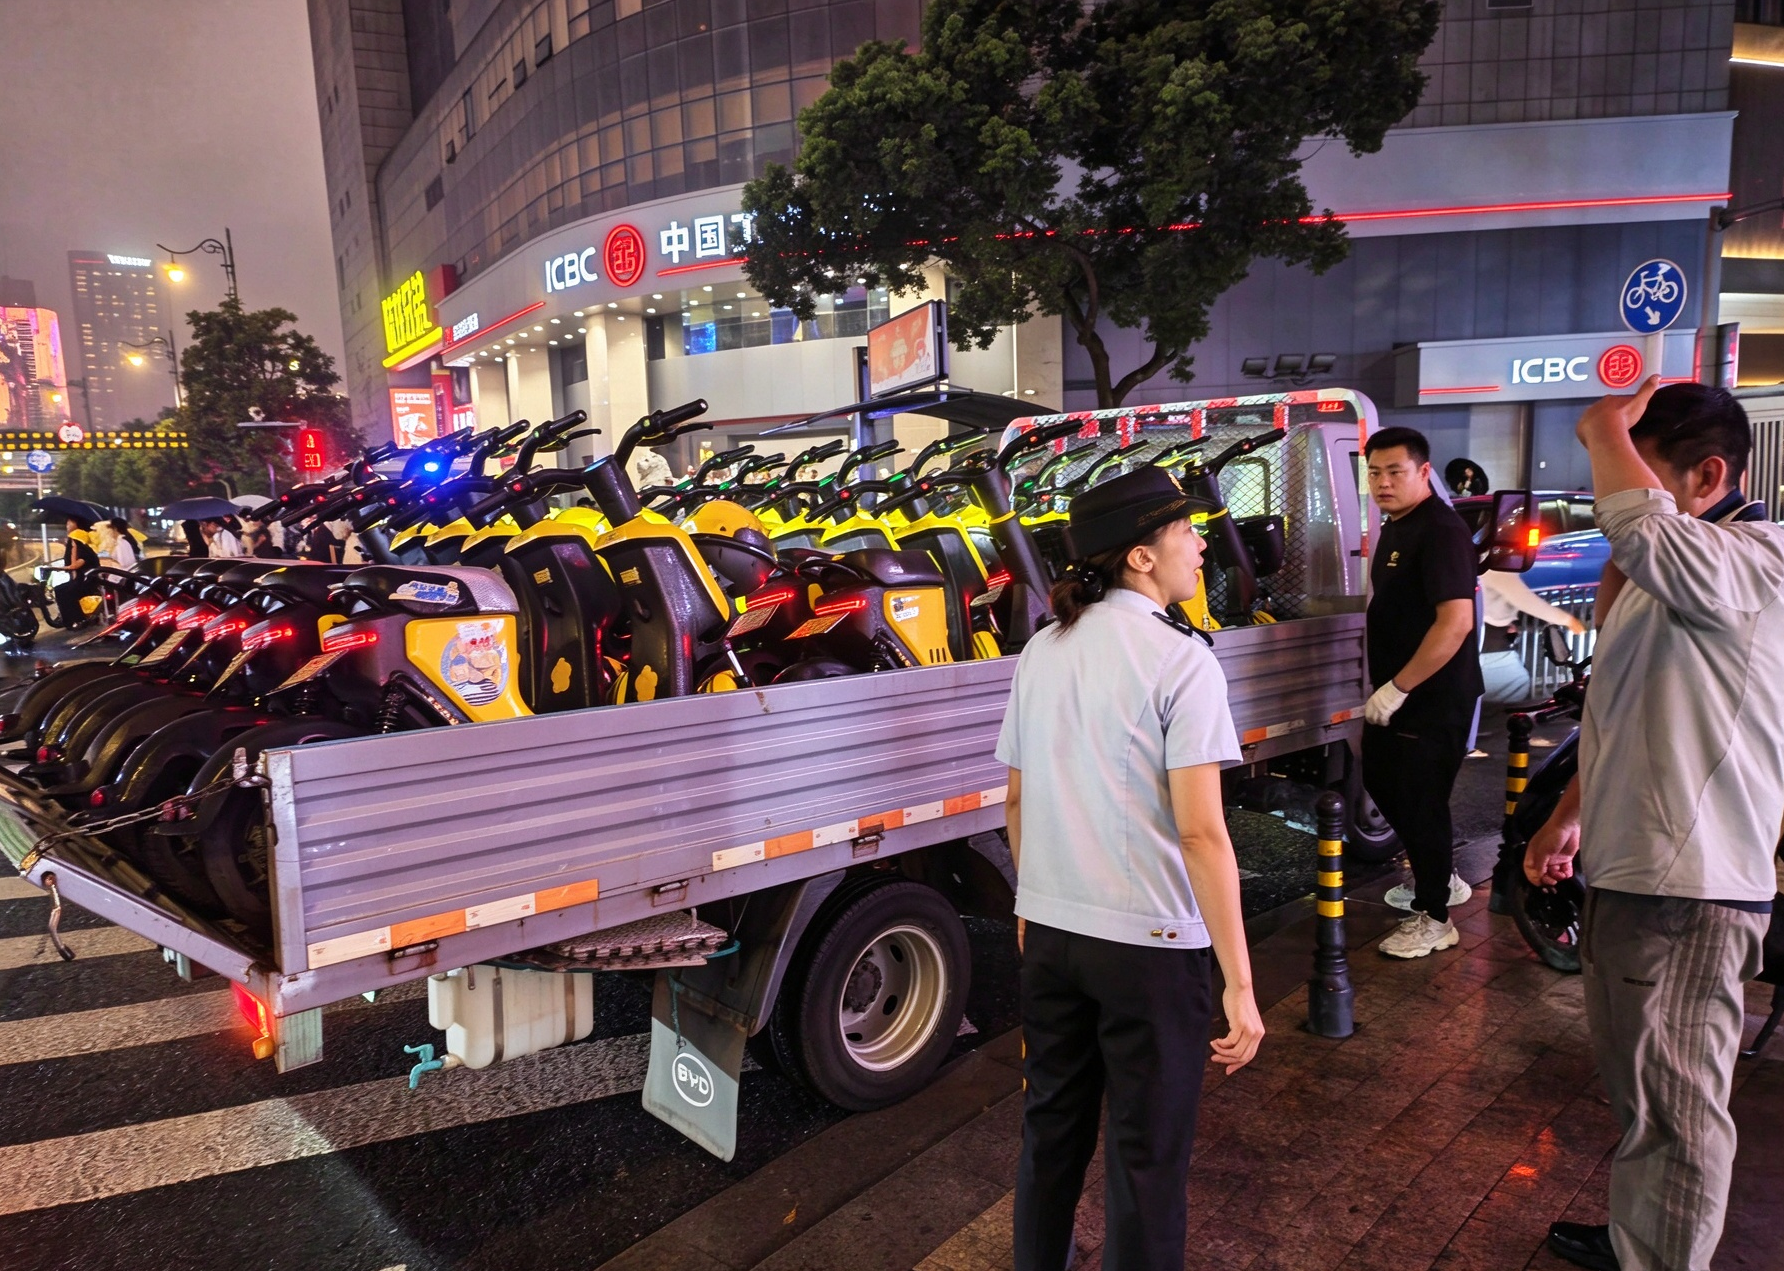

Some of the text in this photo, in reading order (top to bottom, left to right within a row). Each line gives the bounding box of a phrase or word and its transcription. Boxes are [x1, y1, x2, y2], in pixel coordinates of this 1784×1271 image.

[545, 246, 598, 293] ICBC
[1511, 356, 1590, 384] ICBC
[677, 1062, 710, 1096] BYD
